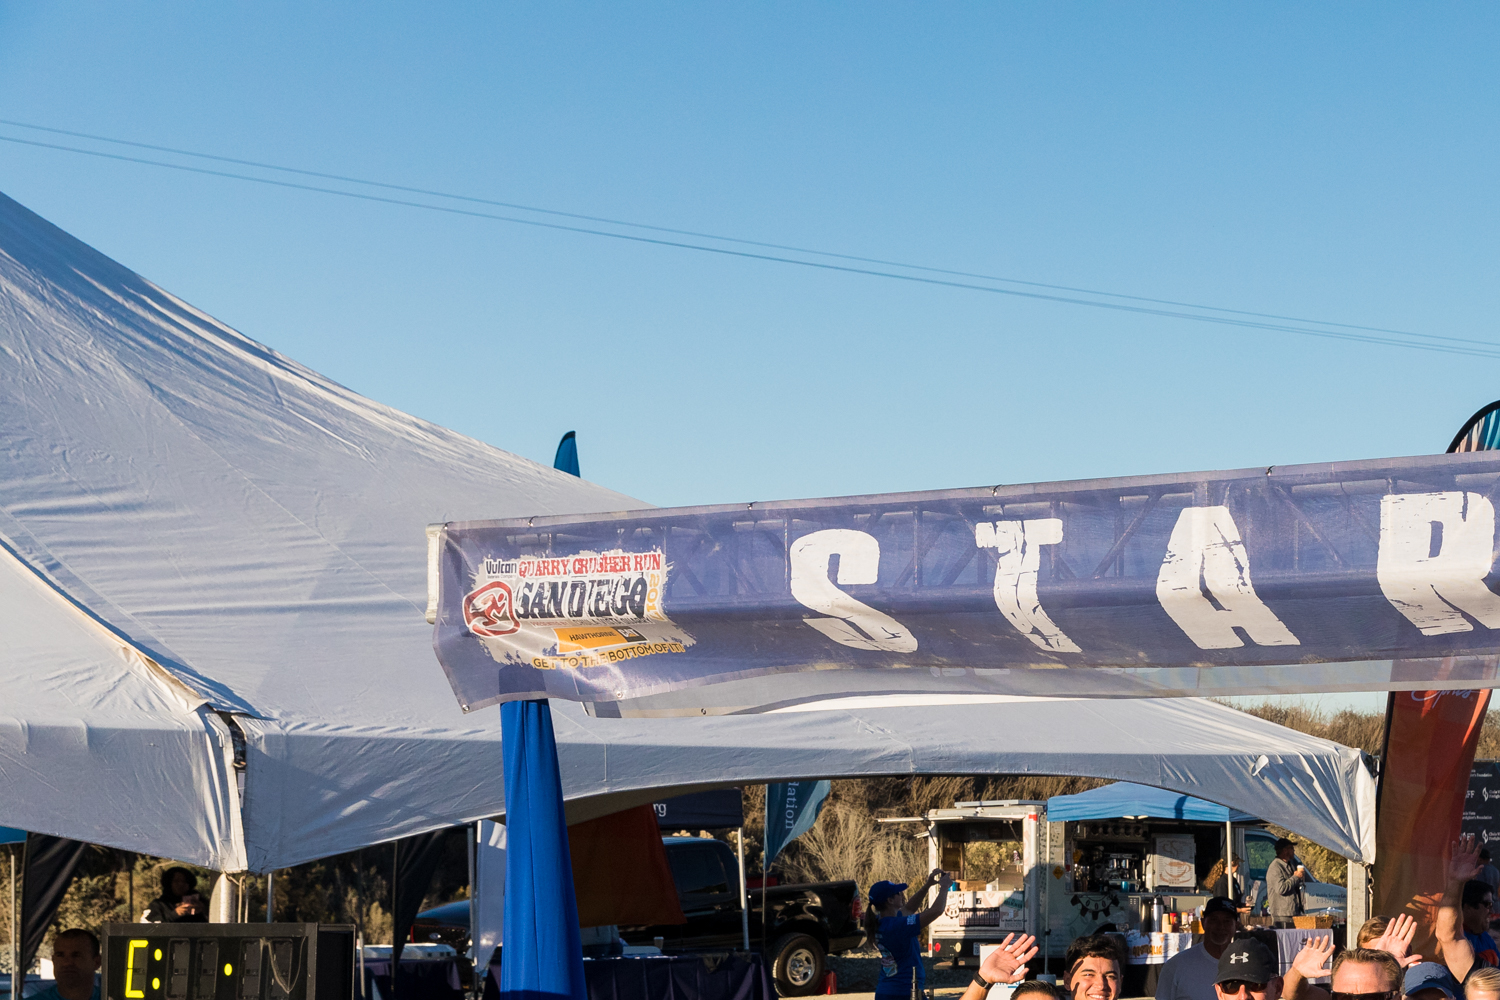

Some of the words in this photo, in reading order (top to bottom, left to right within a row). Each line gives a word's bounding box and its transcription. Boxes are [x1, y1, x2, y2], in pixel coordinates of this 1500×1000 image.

[486, 560, 517, 575] Vulcan
[518, 558, 570, 578] QUARRY
[572, 553, 631, 576] CRUSHER
[633, 553, 661, 571] RUN
[568, 630, 617, 642] HAWTHORNE
[608, 644, 653, 662] BOTTOM
[653, 643, 668, 653] OF
